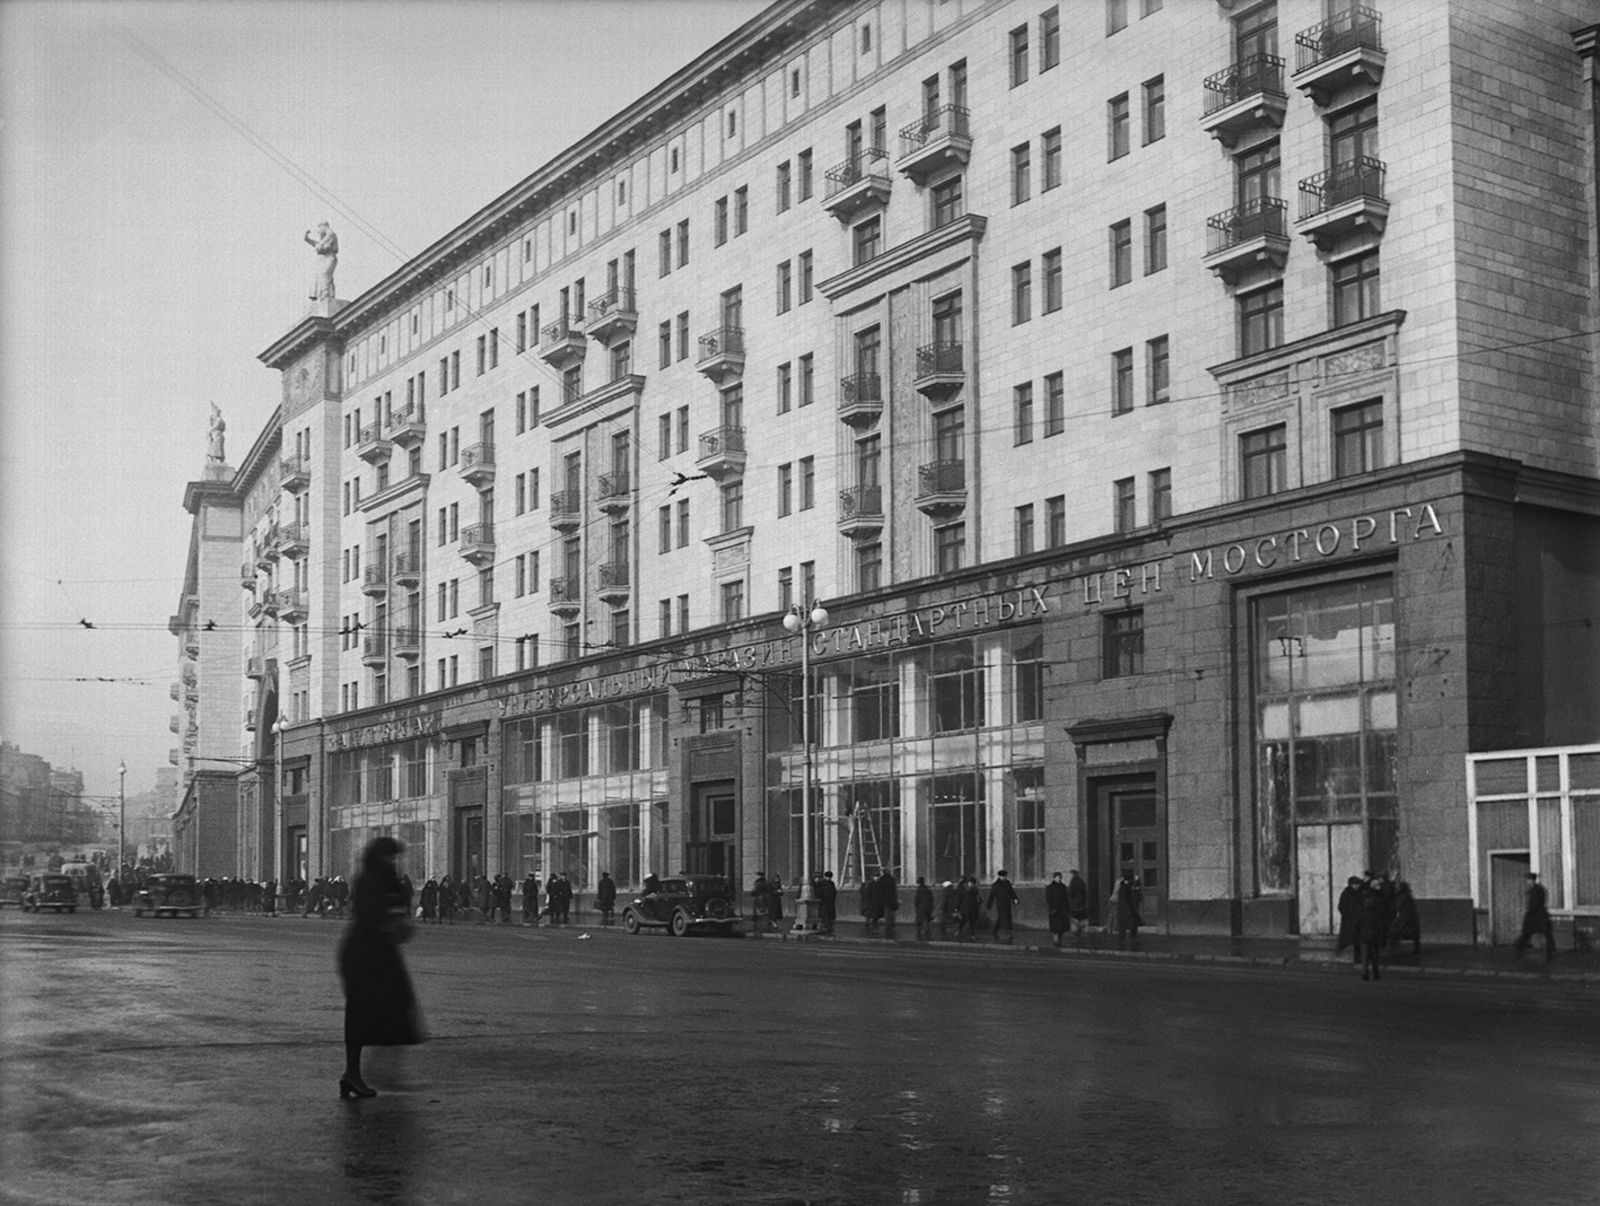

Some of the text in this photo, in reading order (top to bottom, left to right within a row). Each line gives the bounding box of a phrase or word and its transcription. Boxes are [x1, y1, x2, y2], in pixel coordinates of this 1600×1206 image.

[812, 585, 1050, 656] СТАНДАРТНЫХ
[1082, 561, 1162, 605] ЦЕН
[1190, 503, 1443, 582] МОСТОРГА
